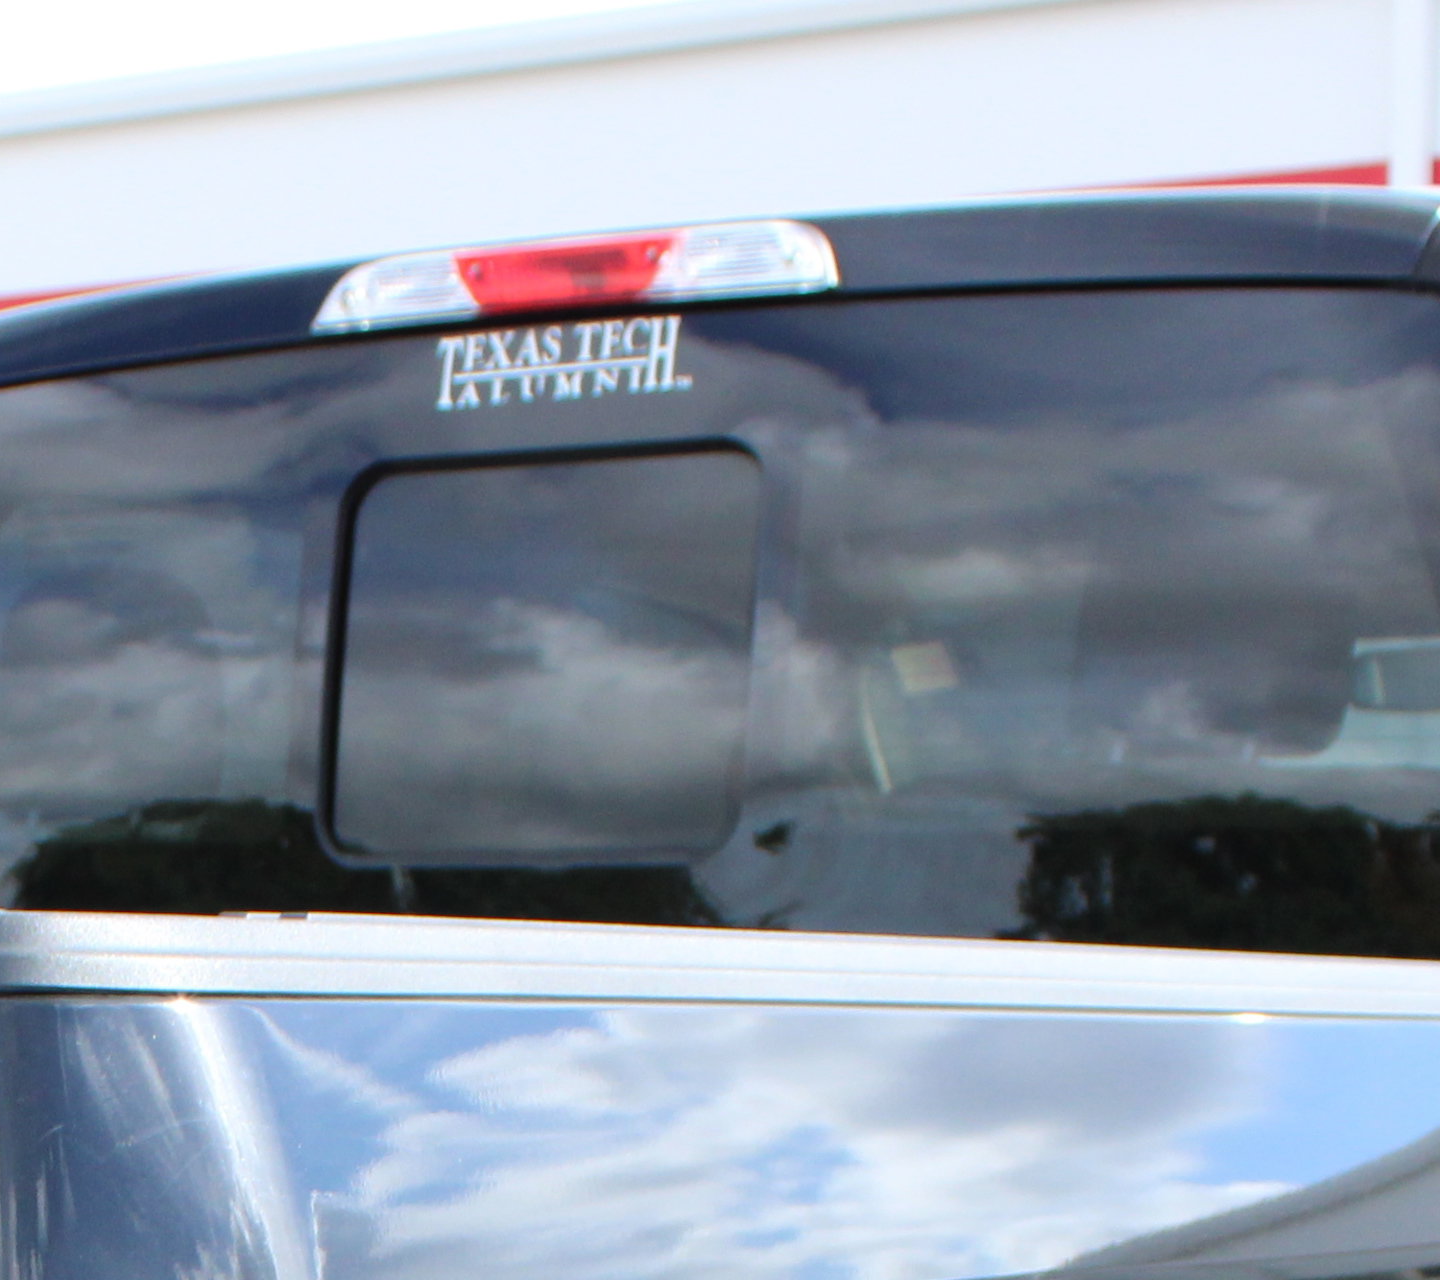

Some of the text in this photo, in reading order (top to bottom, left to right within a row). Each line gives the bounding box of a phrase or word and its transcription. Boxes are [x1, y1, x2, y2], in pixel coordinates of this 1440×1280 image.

[435, 315, 682, 410] TEXAS TECH
[456, 368, 646, 409] ALUMNI
